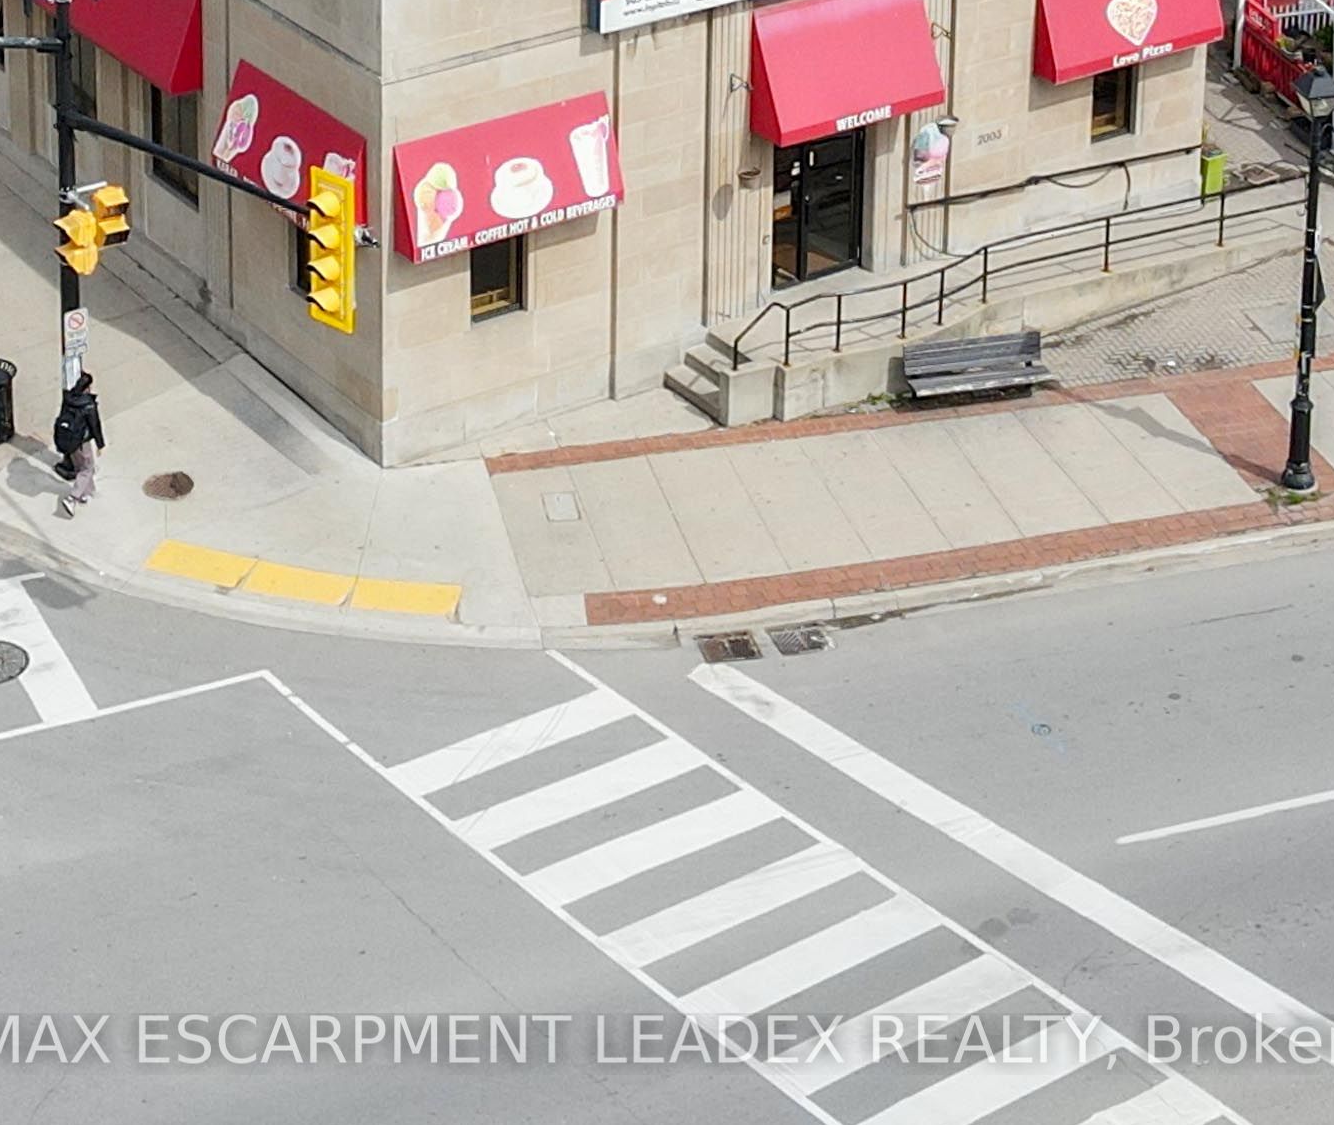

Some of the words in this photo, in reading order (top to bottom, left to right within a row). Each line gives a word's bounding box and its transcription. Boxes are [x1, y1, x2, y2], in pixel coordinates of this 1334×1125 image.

[836, 105, 892, 132] WELCOME
[420, 246, 436, 262] ICE
[437, 236, 469, 256] CREAM
[474, 224, 508, 245] COFFEE
[509, 217, 530, 234] HOT
[530, 216, 538, 229] &
[540, 210, 565, 226] COLD
[566, 194, 616, 219] BEVERAGES
